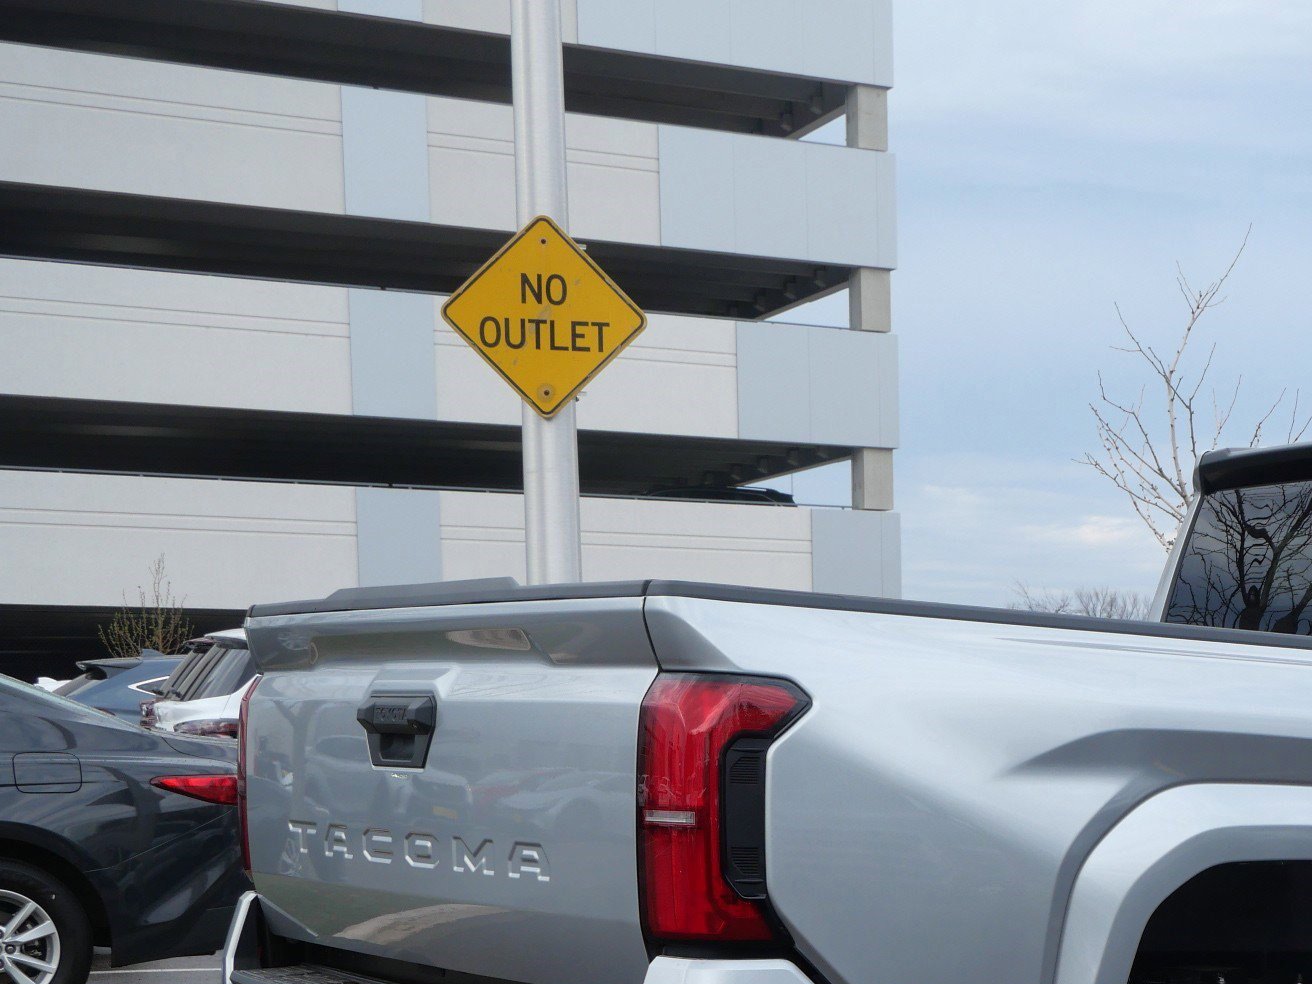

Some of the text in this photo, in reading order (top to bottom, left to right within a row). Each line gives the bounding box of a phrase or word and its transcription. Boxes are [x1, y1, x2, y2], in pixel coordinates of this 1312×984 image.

[520, 272, 568, 306] NO
[479, 316, 610, 353] OUTLET
[288, 819, 550, 882] TACOMA
